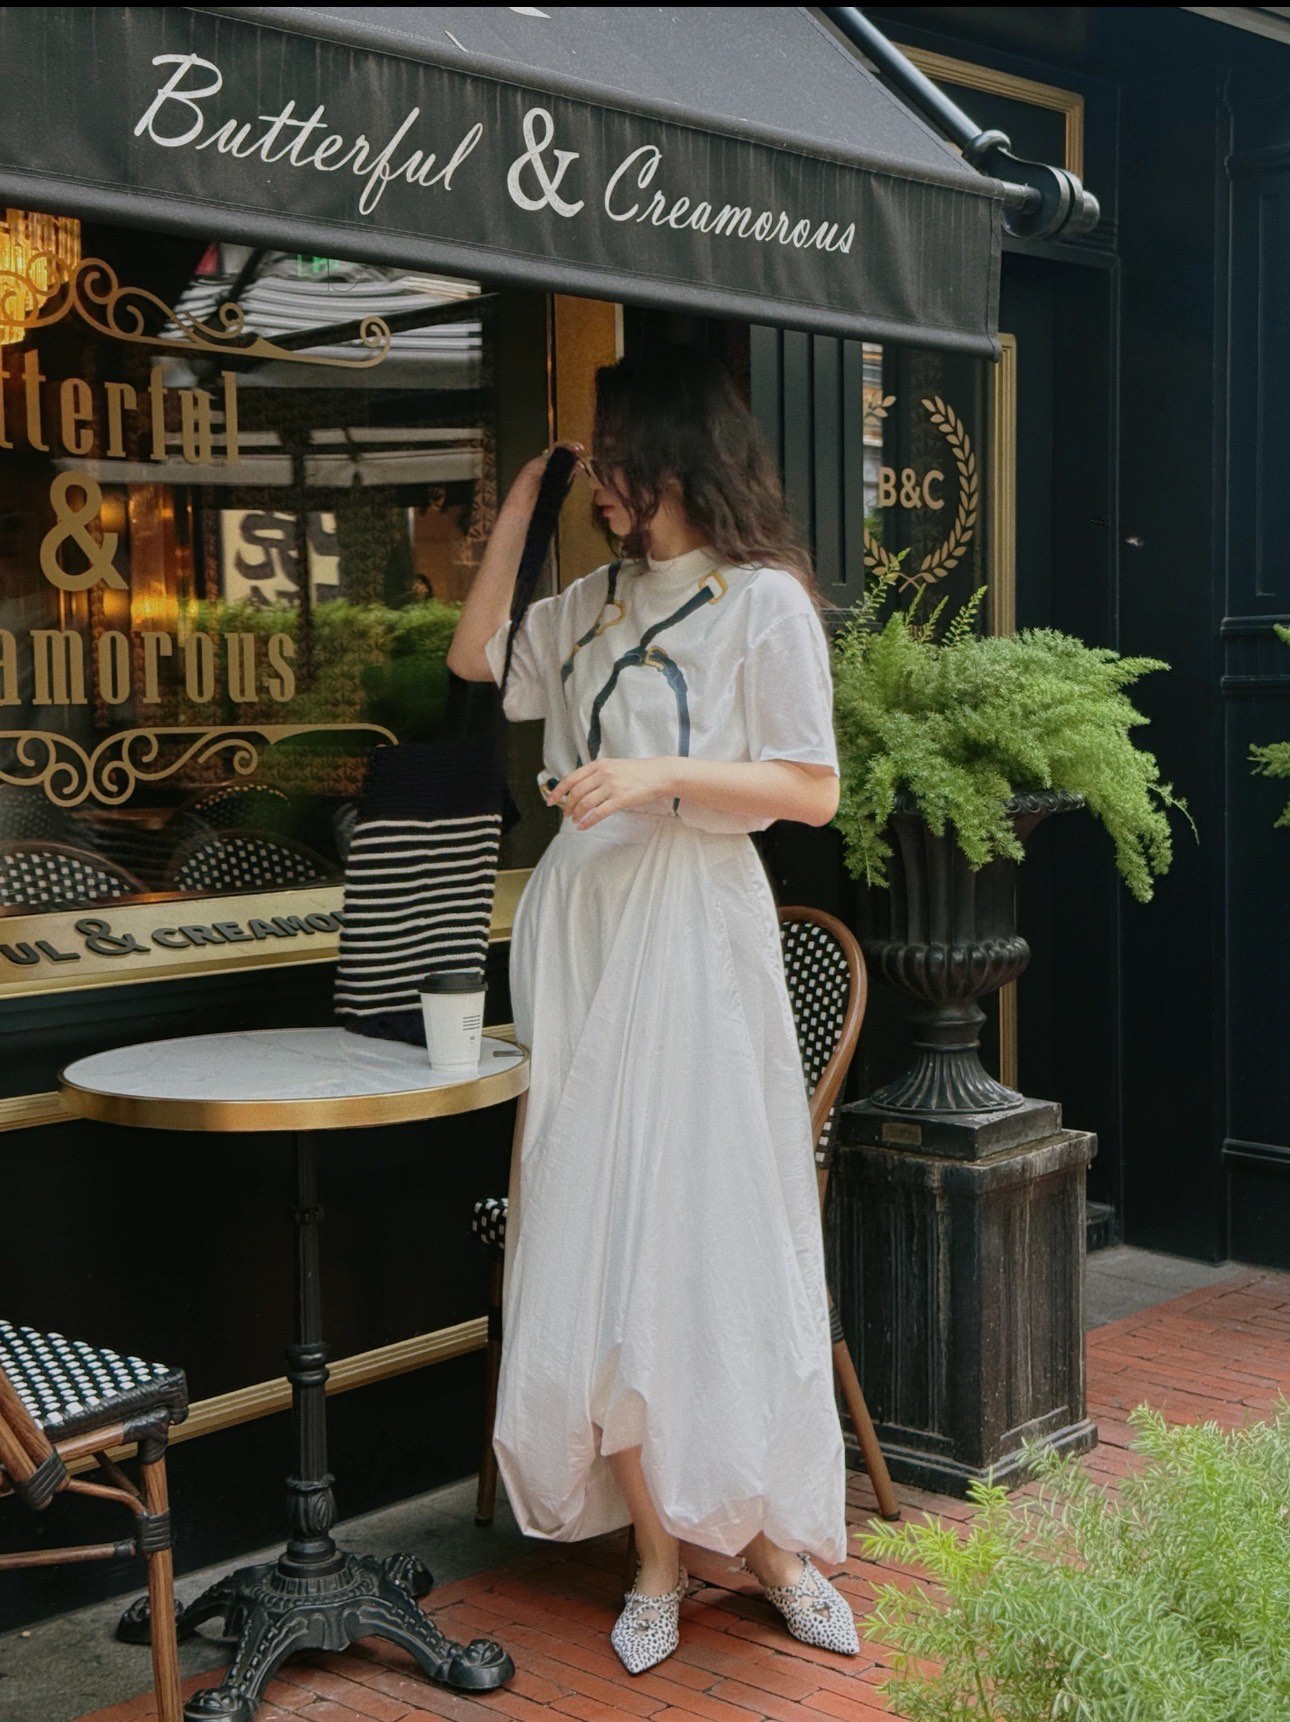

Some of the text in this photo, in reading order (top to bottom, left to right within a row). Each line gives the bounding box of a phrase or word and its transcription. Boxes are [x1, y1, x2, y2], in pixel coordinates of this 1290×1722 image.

[134, 53, 856, 254] Butterful & Creamorous
[878, 466, 945, 510] B&C
[40, 470, 130, 592] &
[75, 918, 151, 956] &
[151, 911, 346, 949] CREAMO
